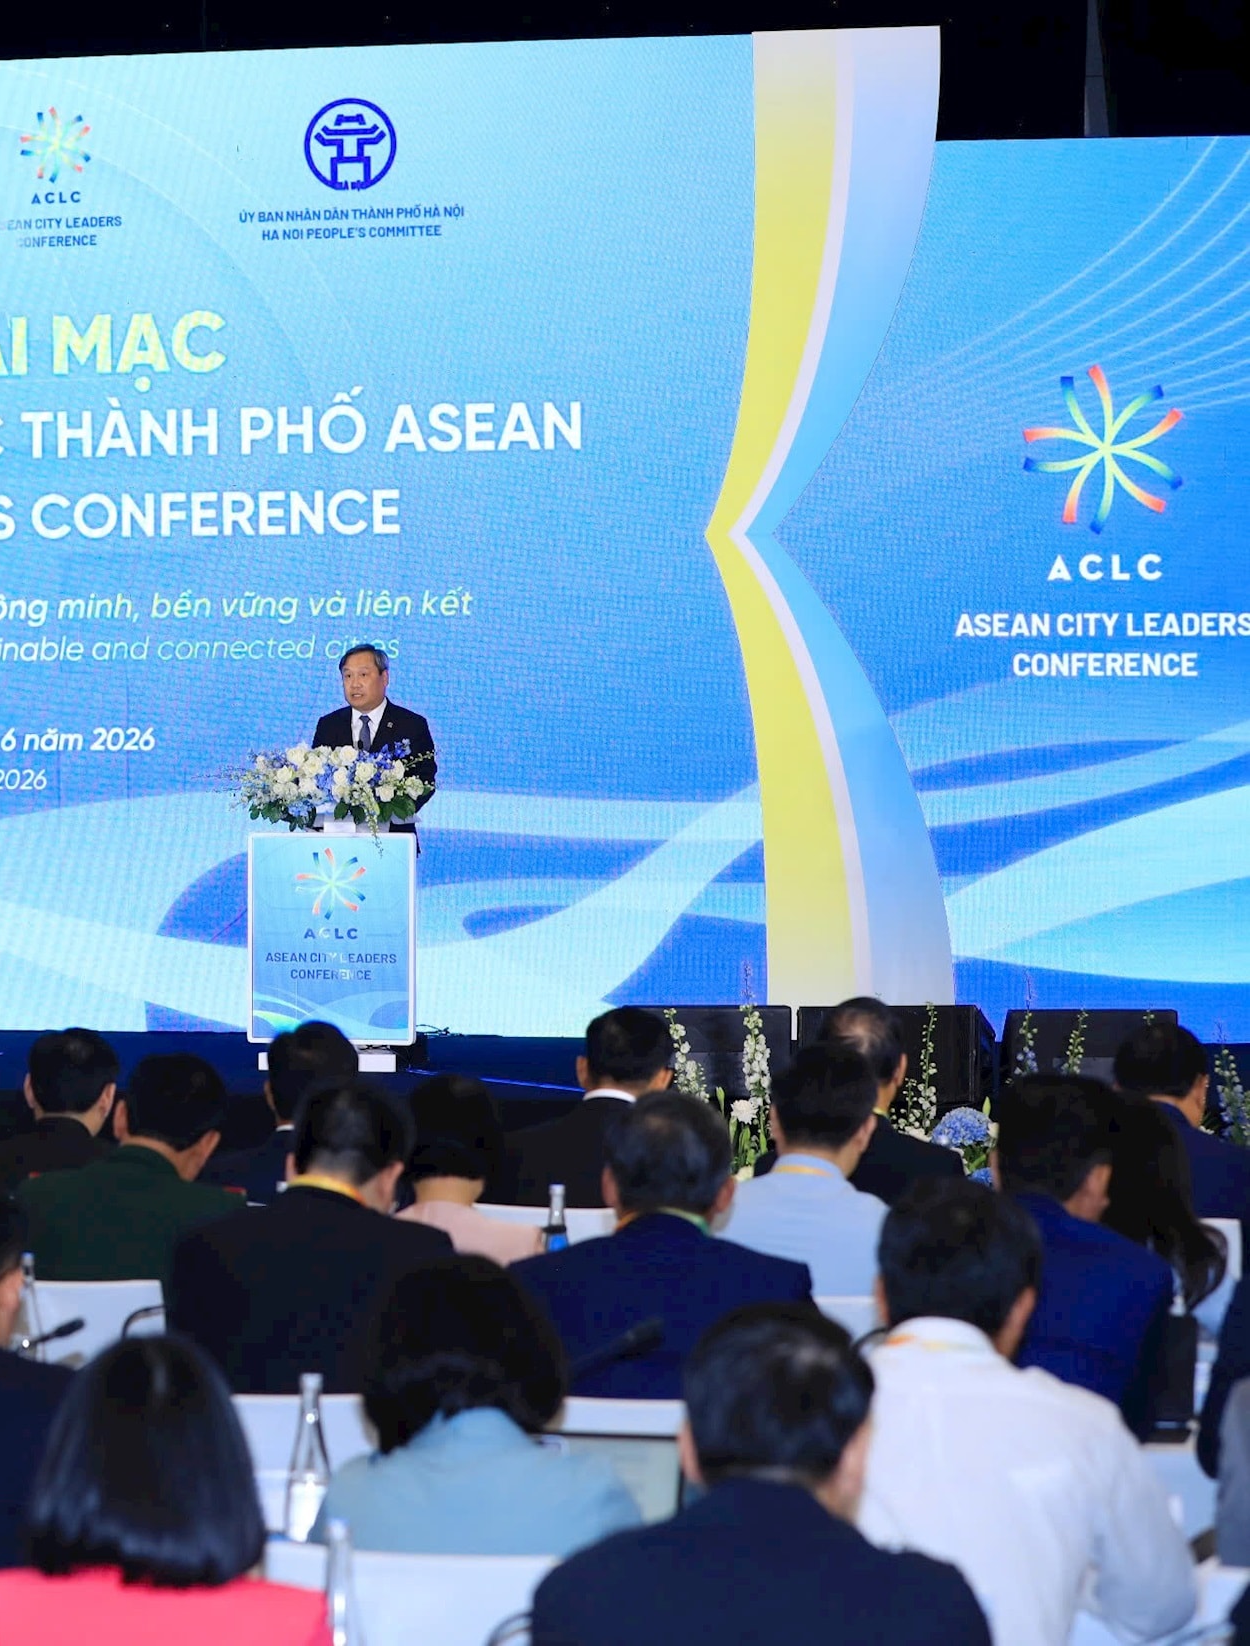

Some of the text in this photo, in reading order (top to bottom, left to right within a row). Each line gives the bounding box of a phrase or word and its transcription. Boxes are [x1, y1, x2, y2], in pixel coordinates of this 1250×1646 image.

[31, 191, 81, 204] ACLC
[35, 218, 62, 229] CITY
[65, 216, 122, 228] LEADERS
[258, 211, 283, 222] BAN
[286, 208, 321, 221] NHÂN
[324, 207, 349, 220] DÂN
[351, 205, 393, 219] THÀNH
[397, 203, 421, 218] PHỐ
[424, 204, 440, 218] HÀ
[444, 203, 464, 220] NỘI
[262, 225, 442, 240] HA NOI PEOPLE'S COMMITTEE
[53, 310, 227, 393] MẠC
[20, 397, 218, 459] THÀNH
[240, 386, 367, 455] PHỐ
[383, 401, 582, 453] ASEAN
[32, 489, 401, 540] CONFERENCE
[1047, 554, 1163, 581] ACLC
[58, 592, 140, 623] minh,
[151, 590, 212, 619] bền
[221, 591, 298, 624] vững
[309, 590, 348, 617] và
[356, 590, 412, 617] liên
[420, 587, 472, 617] kết
[955, 612, 1250, 637] ASEAN CITY LEADERS
[92, 637, 148, 661] and
[157, 634, 317, 661] connected
[1013, 653, 1198, 677] CONFERENCE
[0, 728, 17, 752] 6
[23, 729, 86, 752] năm
[91, 727, 154, 751] 2026
[265, 952, 307, 963] ASEAN
[340, 952, 397, 964] LEADERS
